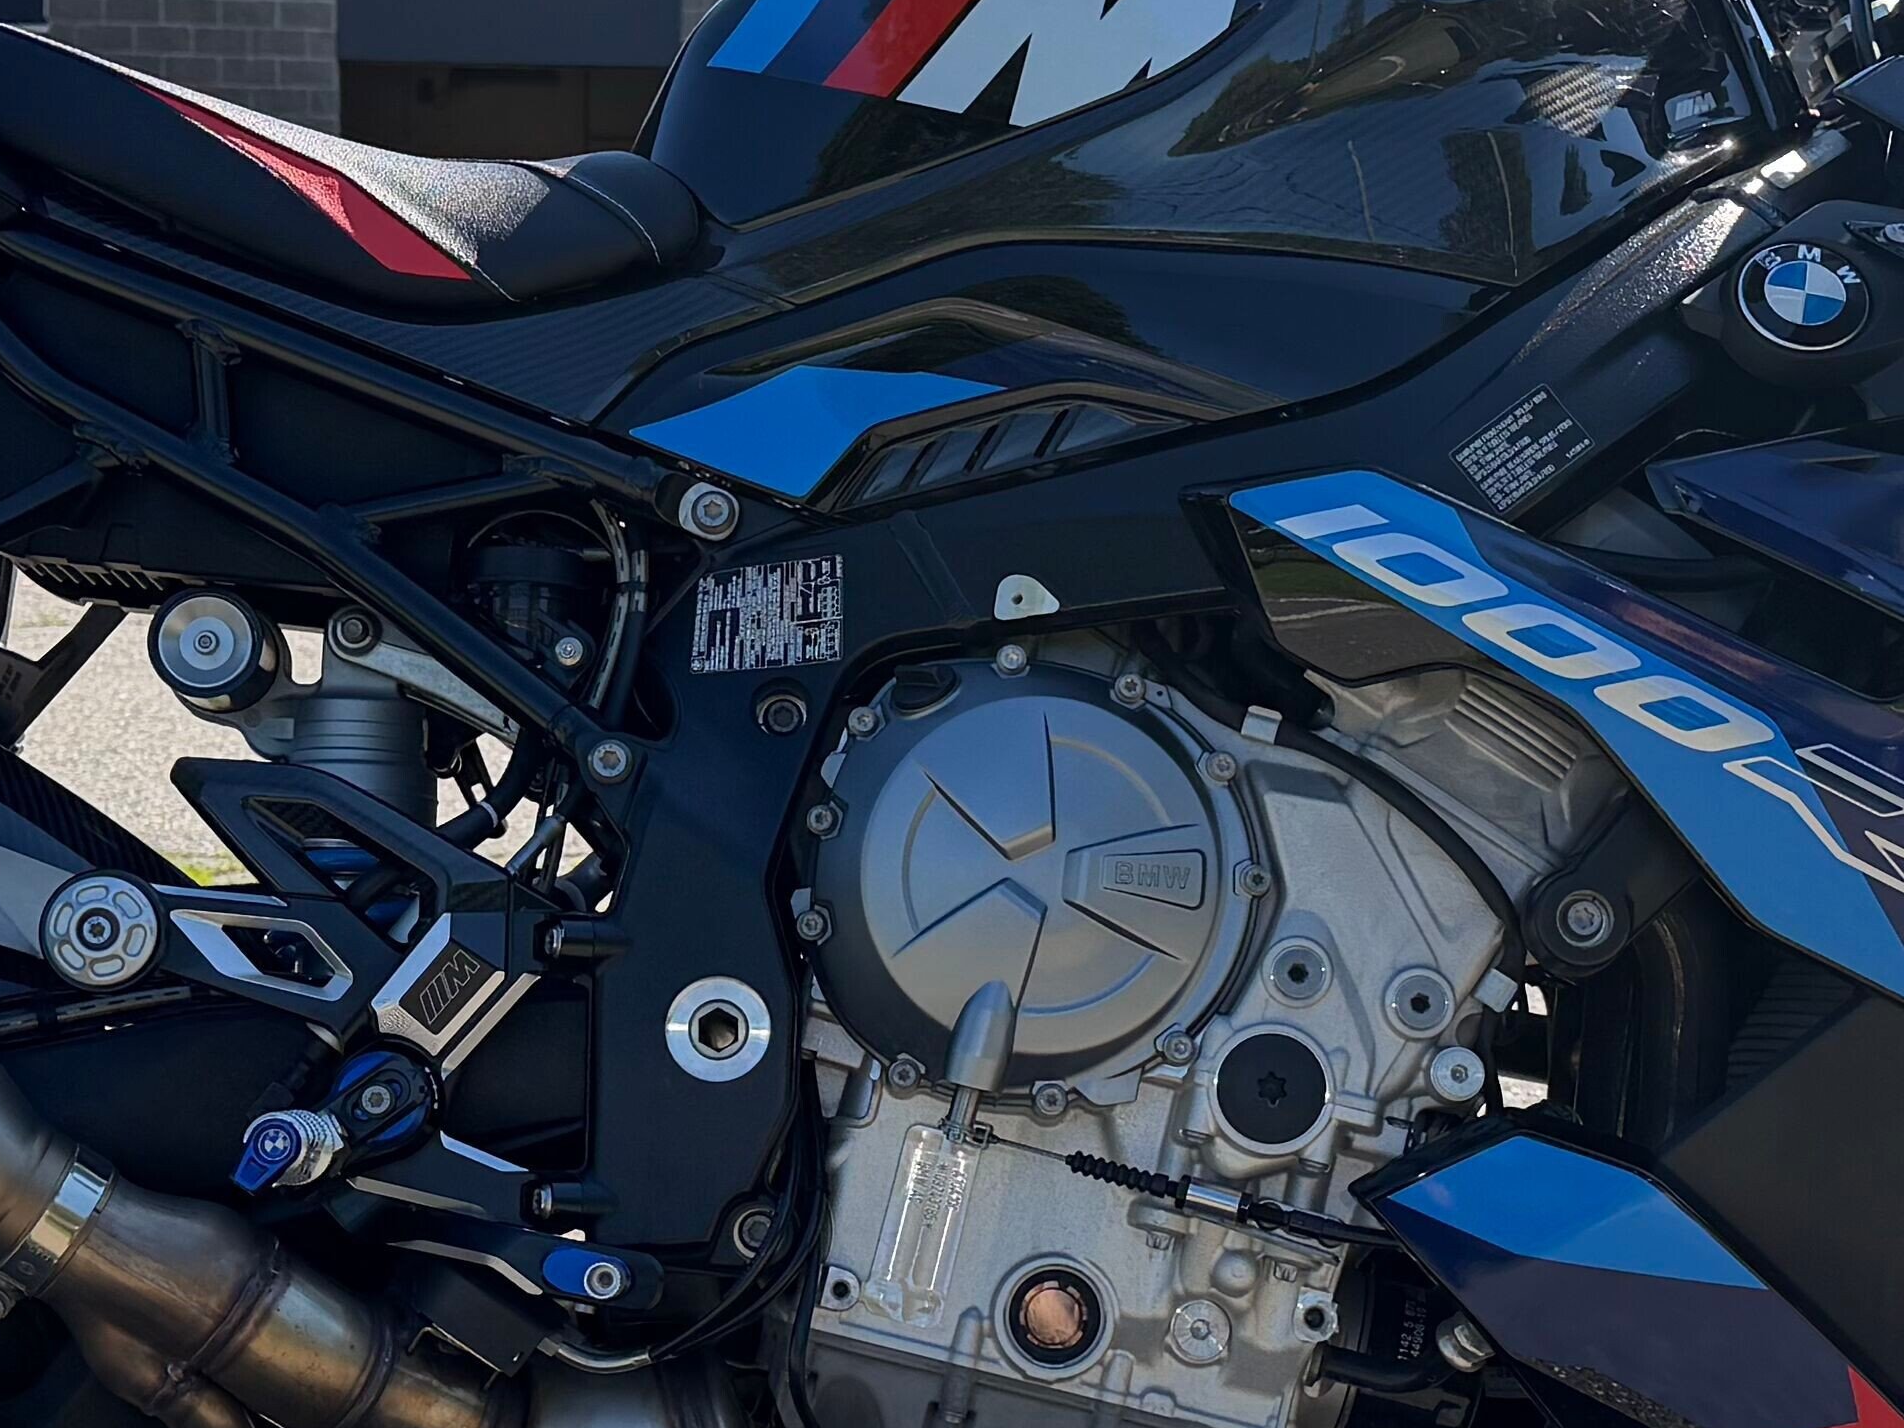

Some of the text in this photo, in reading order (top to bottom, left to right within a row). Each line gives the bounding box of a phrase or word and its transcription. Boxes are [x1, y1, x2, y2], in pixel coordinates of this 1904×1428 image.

[1754, 244, 1862, 285] BMW
[1275, 504, 1777, 753] 1000
[1114, 860, 1191, 891] BMW
